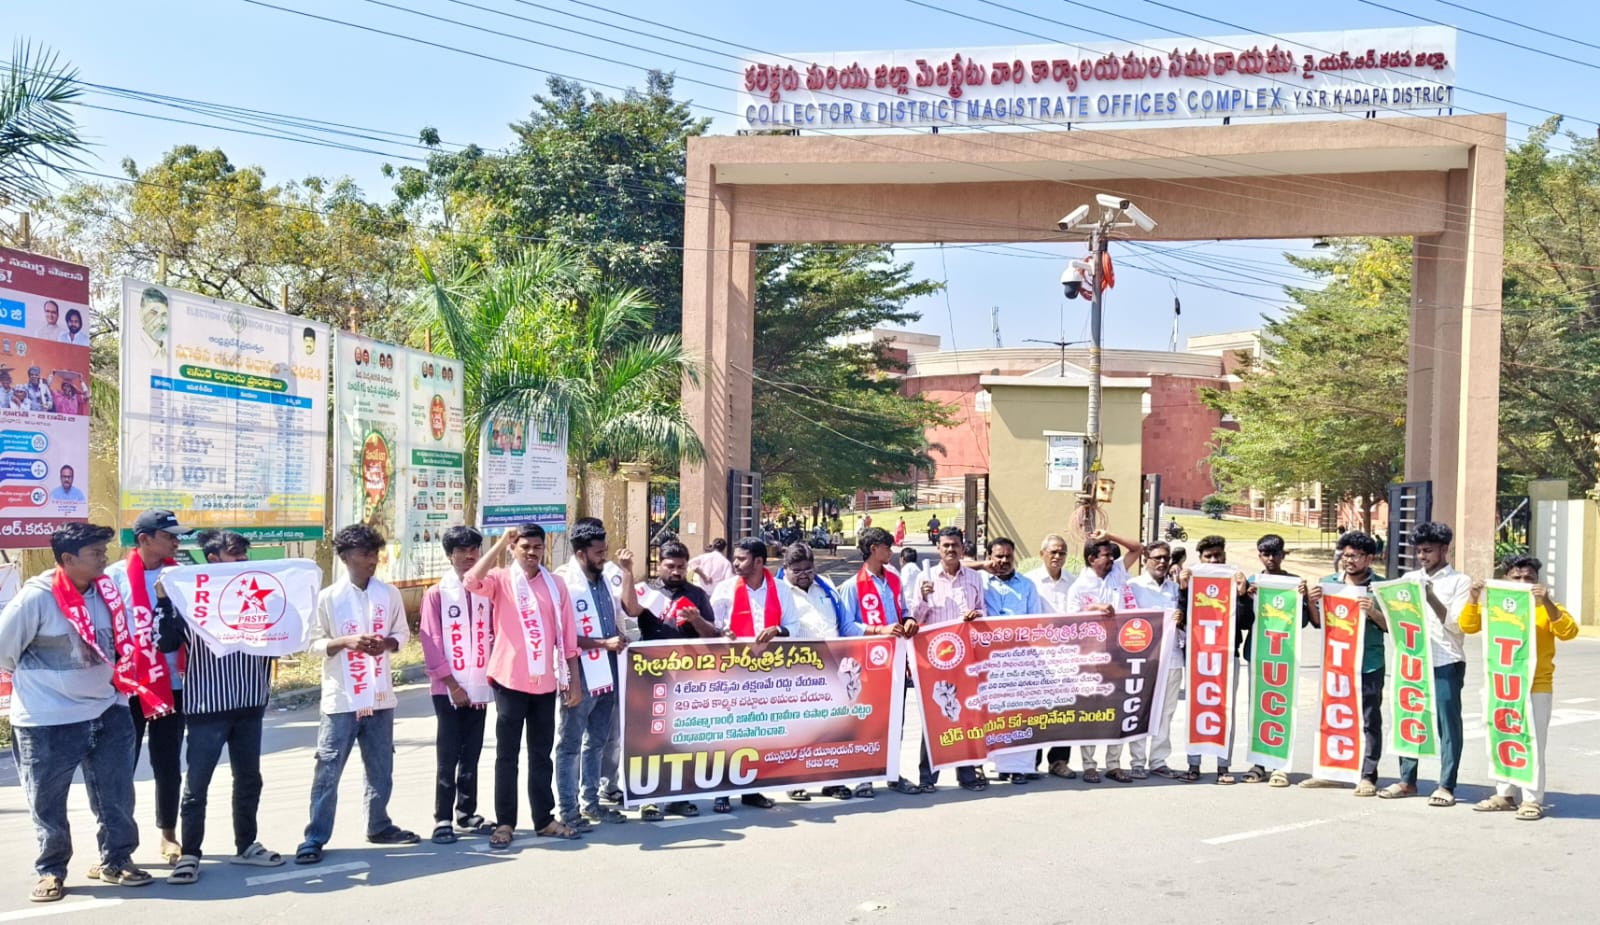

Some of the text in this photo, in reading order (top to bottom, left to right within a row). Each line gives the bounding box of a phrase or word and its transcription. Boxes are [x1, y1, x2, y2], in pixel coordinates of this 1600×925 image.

[806, 61, 869, 90] మరియు
[874, 63, 909, 94] జిల్లా
[990, 59, 1024, 85] వారి
[746, 101, 854, 125] COLLECTOR
[860, 101, 870, 122] &
[878, 98, 961, 122] DISTRICT
[967, 95, 1088, 120] MAGISTRATE
[1393, 85, 1453, 105] DISTRICT
[238, 614, 269, 624] PRSYF
[521, 610, 543, 661] PRSYF
[1016, 628, 1029, 641] 12
[451, 633, 465, 671] PSU
[476, 632, 485, 669] PSU
[583, 625, 600, 661] PU
[696, 654, 716, 671] 12
[785, 645, 824, 670] సమ్మె
[674, 684, 681, 693] 4
[683, 681, 706, 693] లేబర్
[776, 677, 792, 692] రద్దు
[1121, 658, 1146, 732] TUCC
[1195, 620, 1223, 736] TUCC
[1259, 630, 1289, 747] TUCC
[1398, 621, 1427, 745] TUCC
[674, 700, 689, 711] 29
[1326, 639, 1354, 761] TUCC
[1494, 637, 1527, 768] TUCC
[629, 747, 760, 795] UTUC
